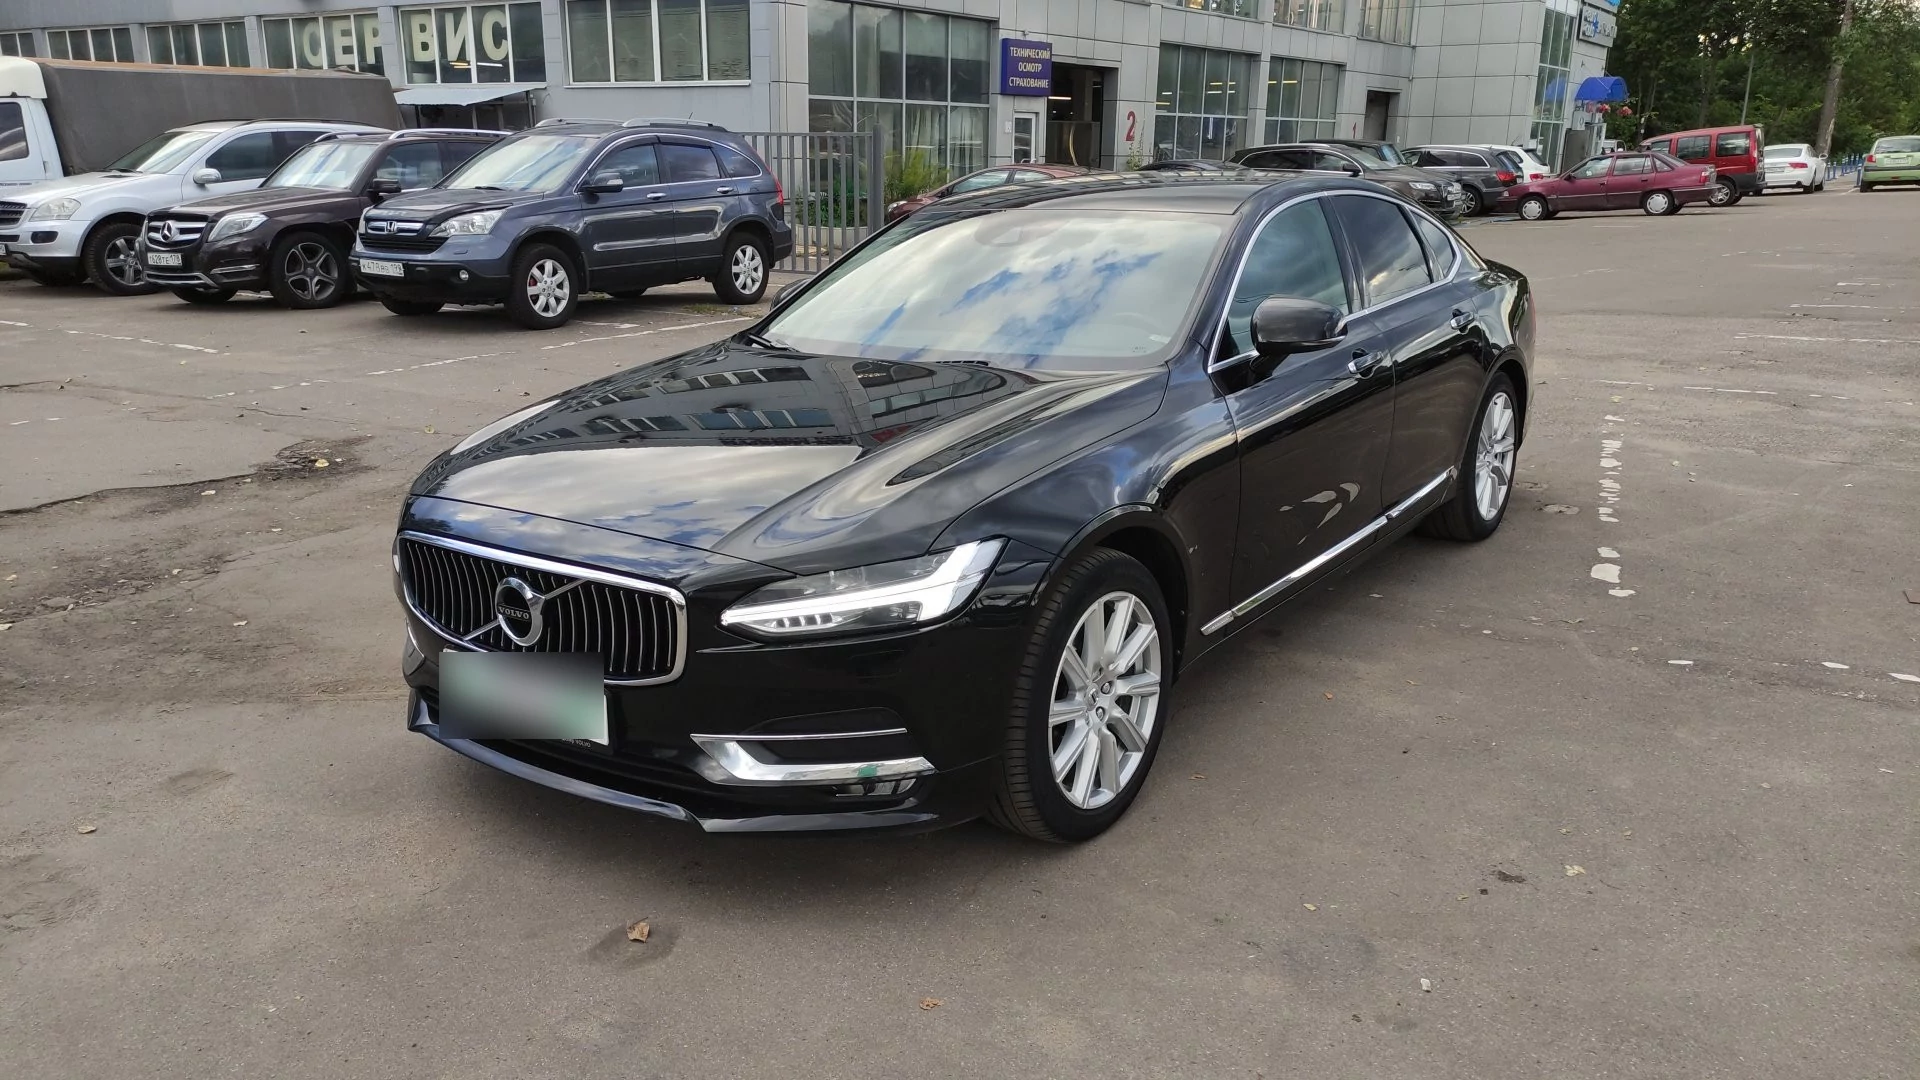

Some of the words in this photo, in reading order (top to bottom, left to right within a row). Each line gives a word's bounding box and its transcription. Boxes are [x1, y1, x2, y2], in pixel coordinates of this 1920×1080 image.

[1010, 47, 1051, 60] ТЕХНИЧЕСКИЙ
[1018, 62, 1042, 73] ОСМОТР
[1008, 77, 1049, 89] СТРАХОВАНИЕ
[1125, 110, 1137, 142] 2
[498, 606, 530, 619] VOLVO
